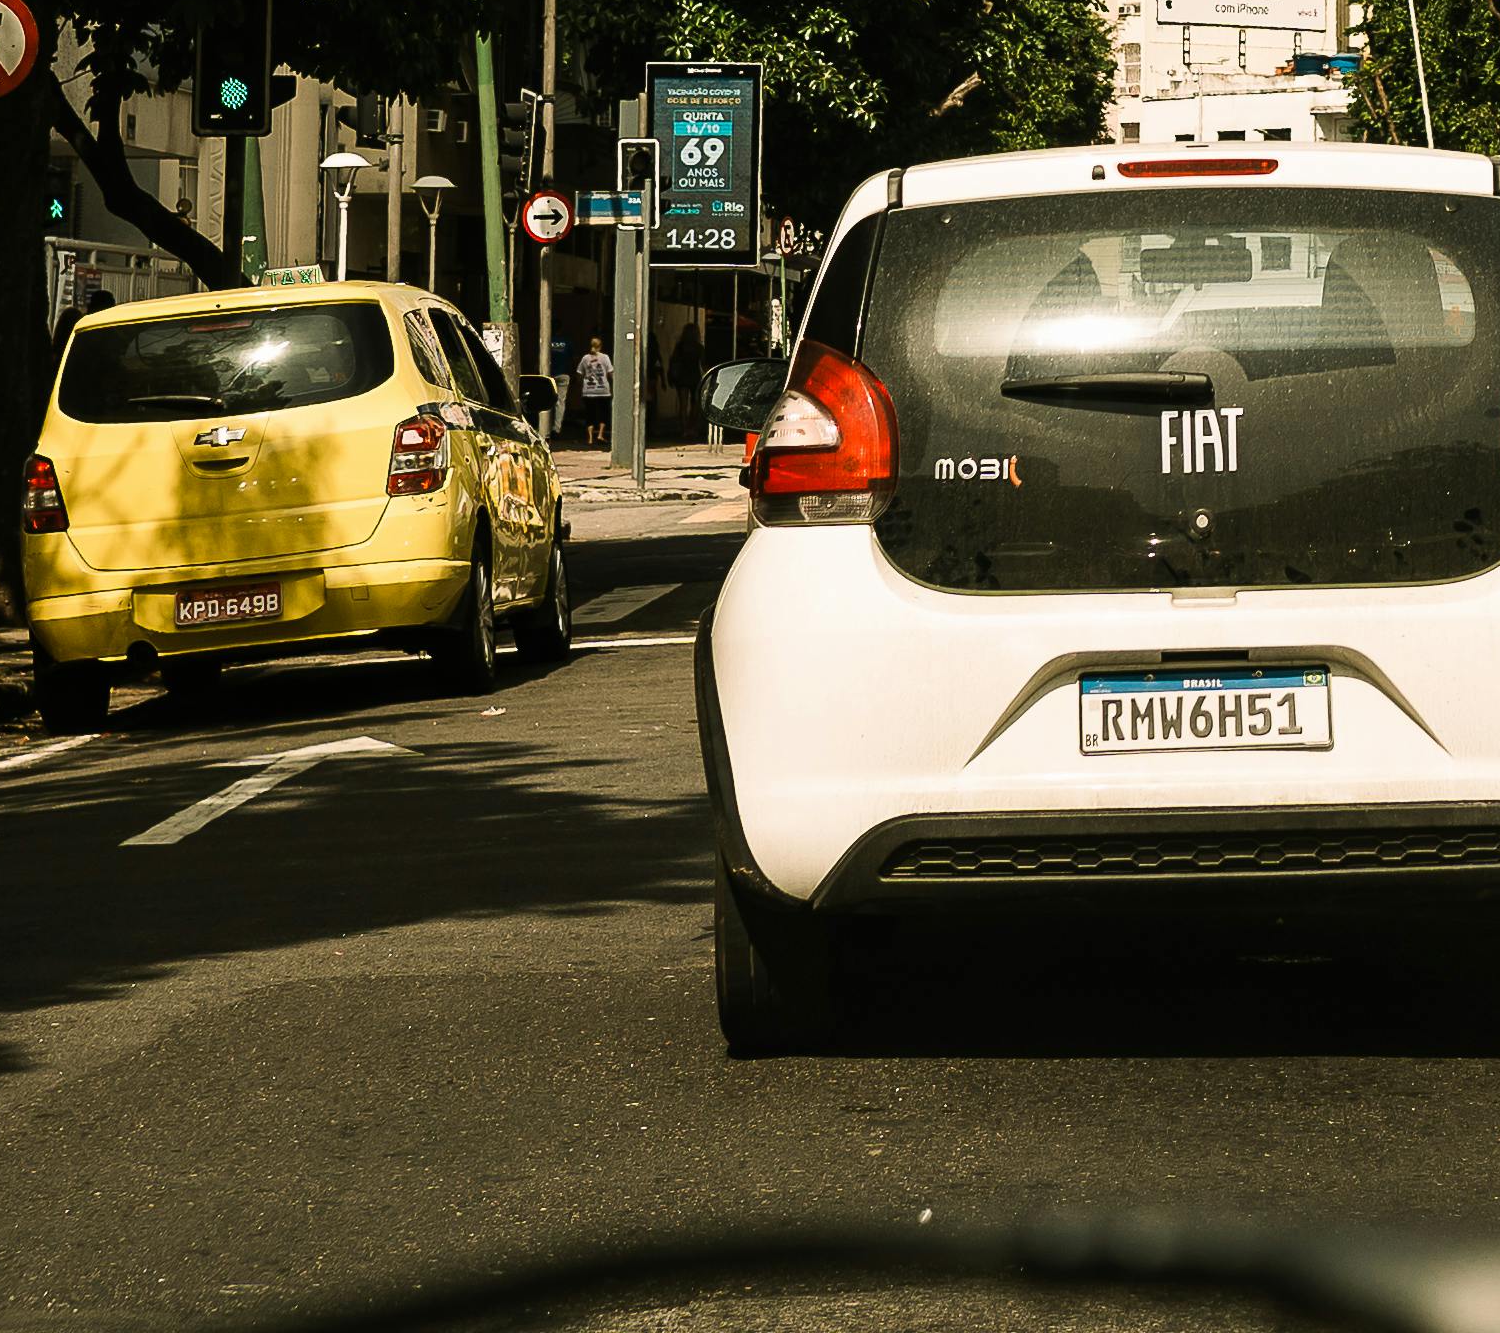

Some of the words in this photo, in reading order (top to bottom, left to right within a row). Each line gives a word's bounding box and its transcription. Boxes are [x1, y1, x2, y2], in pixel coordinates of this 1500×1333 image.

[1215, 4, 1235, 13] com
[1237, 3, 1270, 15] iPhone
[683, 112, 724, 123] QUINTA
[680, 138, 725, 166] 69
[687, 168, 718, 177] ANOS
[679, 178, 697, 187] OU
[699, 178, 725, 187] MAIS
[724, 201, 744, 213] Rio
[666, 228, 736, 250] 14:28
[265, 267, 321, 286] TAXI
[1161, 408, 1244, 474] FIAT
[1183, 679, 1223, 688] BRASIL
[1101, 692, 1303, 742] RMW6H51
[1085, 733, 1099, 748] BR
